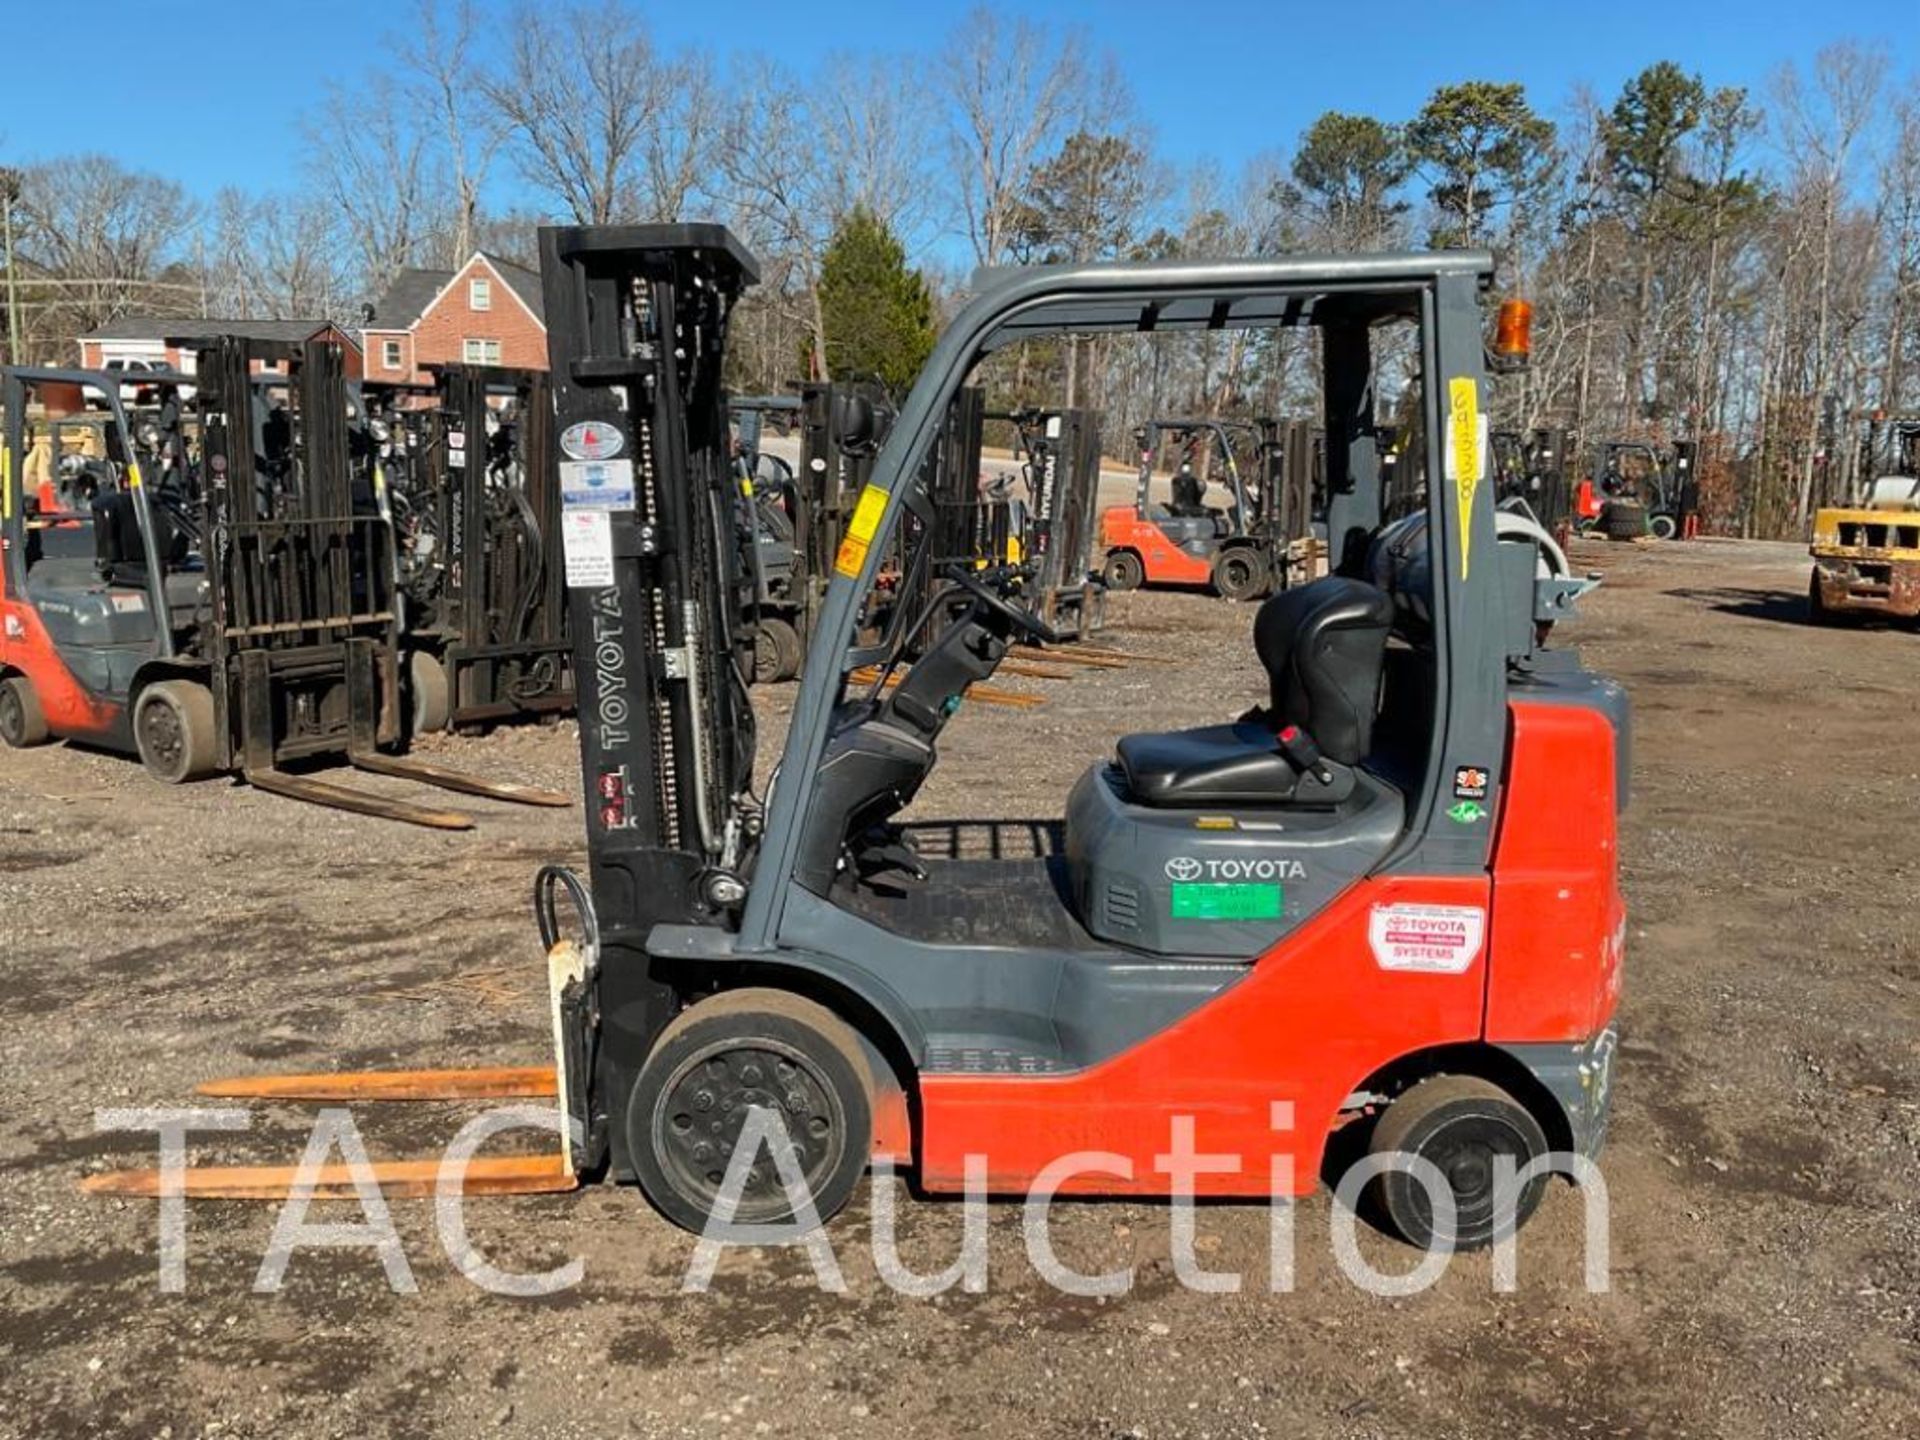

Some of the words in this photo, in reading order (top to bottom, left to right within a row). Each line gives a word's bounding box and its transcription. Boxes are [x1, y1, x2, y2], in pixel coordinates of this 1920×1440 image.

[1041, 455, 1056, 520] HYUNDAI
[594, 585, 629, 750] TOYOTA
[1206, 860, 1306, 879] TOYOTA
[1411, 919, 1466, 932] TOYOTA
[1393, 946, 1454, 959] SYSTEMS
